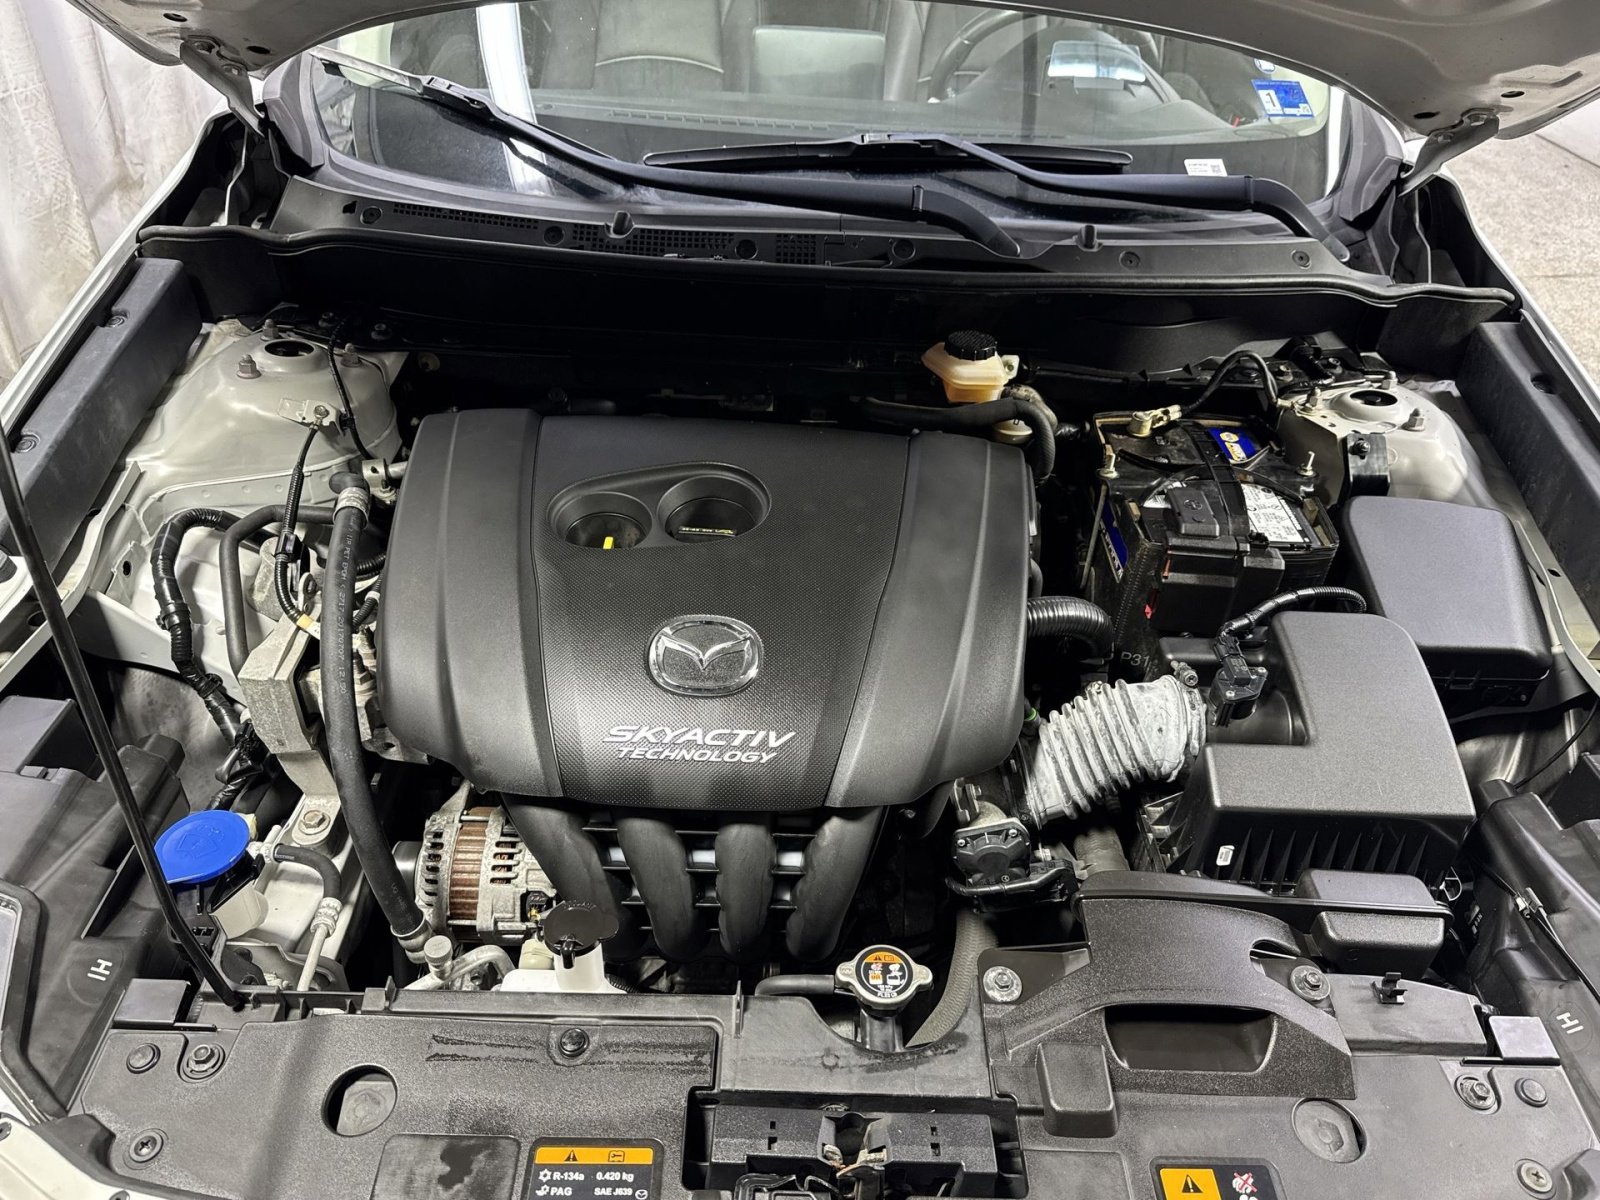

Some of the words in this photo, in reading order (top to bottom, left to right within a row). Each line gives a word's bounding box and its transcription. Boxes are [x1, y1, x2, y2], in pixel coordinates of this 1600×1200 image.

[1265, 92, 1276, 107] 1
[602, 725, 796, 748] SKYACTIV
[618, 747, 777, 763] TECHNOLOGY
[552, 1172, 585, 1181] R-134a
[596, 1172, 621, 1181] 0.420
[622, 1172, 635, 1183] kg
[550, 1187, 573, 1196] PAG
[594, 1187, 612, 1196] SAE
[613, 1187, 633, 1196] J639
